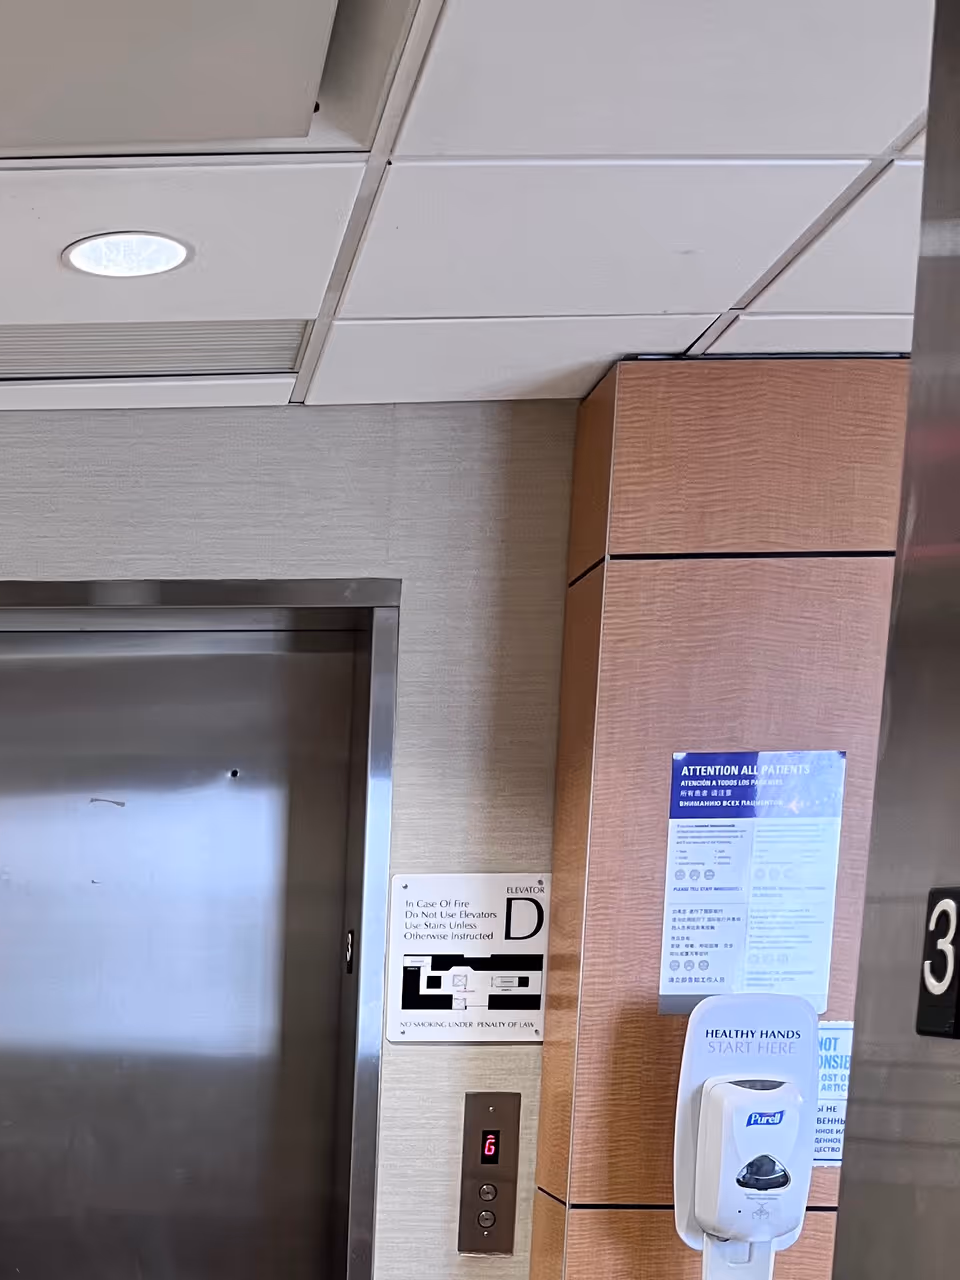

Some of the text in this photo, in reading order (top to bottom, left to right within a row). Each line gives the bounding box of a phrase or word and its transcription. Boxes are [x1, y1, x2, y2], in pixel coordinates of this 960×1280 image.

[681, 764, 810, 776] ATTENTION ALL PATIENTS
[680, 779, 711, 787] ATENCIÓN
[506, 886, 545, 894] ELEVATOR
[405, 899, 470, 908] In Case Of Fire
[405, 910, 498, 919] Do Not Use Elevators
[504, 897, 545, 941] D
[404, 921, 477, 930] Use Stairs Unless
[403, 931, 494, 941] Otherwise Instructed
[346, 933, 352, 962] 3
[923, 898, 957, 995] 3
[705, 1029, 801, 1039] HEALTHY HANDS
[707, 1041, 797, 1054] START HERE
[826, 1105, 838, 1113] НЕ
[750, 1113, 781, 1125] Purell
[484, 1139, 496, 1155] G
